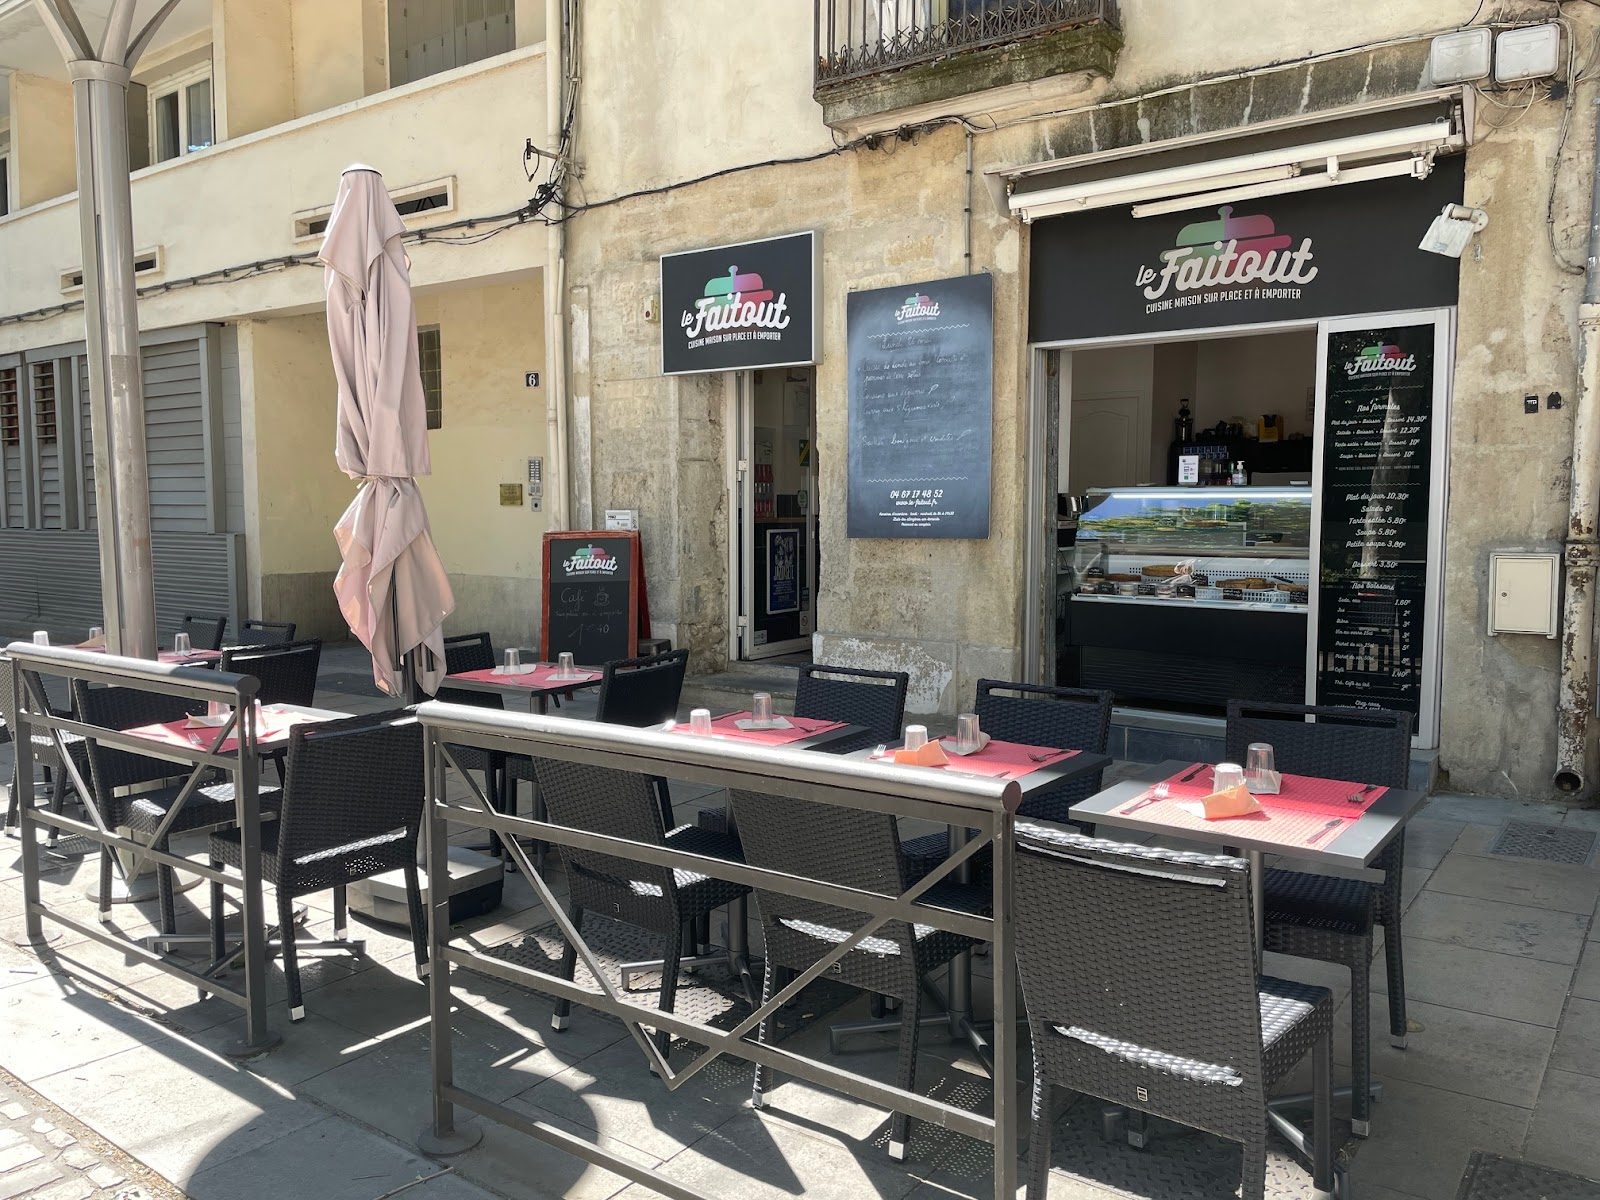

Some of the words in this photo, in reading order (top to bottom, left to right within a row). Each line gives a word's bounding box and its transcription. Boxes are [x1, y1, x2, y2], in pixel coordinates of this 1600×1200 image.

[1135, 264, 1157, 287] le
[1143, 237, 1318, 300] Faitout
[1145, 299, 1173, 314] CUISINE
[1174, 295, 1202, 308] MAISON
[1203, 292, 1219, 304] SUR
[1220, 289, 1242, 301] PLACE
[1244, 289, 1253, 300] ET
[1254, 286, 1260, 299] À
[1261, 288, 1301, 299] EMPORTER
[680, 309, 695, 328] le
[686, 292, 791, 338] Faitout
[897, 302, 940, 321] Faitout
[688, 338, 705, 349] CUISINE
[705, 335, 722, 346] MAISON
[722, 333, 732, 343] SUR
[732, 332, 747, 341] PLACE
[747, 331, 753, 340] ET
[757, 331, 781, 341] EMPORTER
[1344, 361, 1354, 370] le
[1348, 354, 1416, 375] Faitout
[528, 374, 536, 387] 6
[1357, 404, 1369, 413] Nos
[1370, 403, 1400, 413] formules
[890, 489, 900, 499] 04
[901, 489, 911, 499] 67
[911, 489, 921, 498] 17
[922, 489, 932, 498] 48
[933, 489, 943, 498] 52
[1368, 493, 1385, 501] jour
[1349, 517, 1366, 525] Tarte
[1366, 516, 1386, 524] salée
[1355, 529, 1377, 537] Soupe
[565, 554, 618, 572] Faitout
[1352, 582, 1364, 590] Nos
[1366, 581, 1395, 591] boissons
